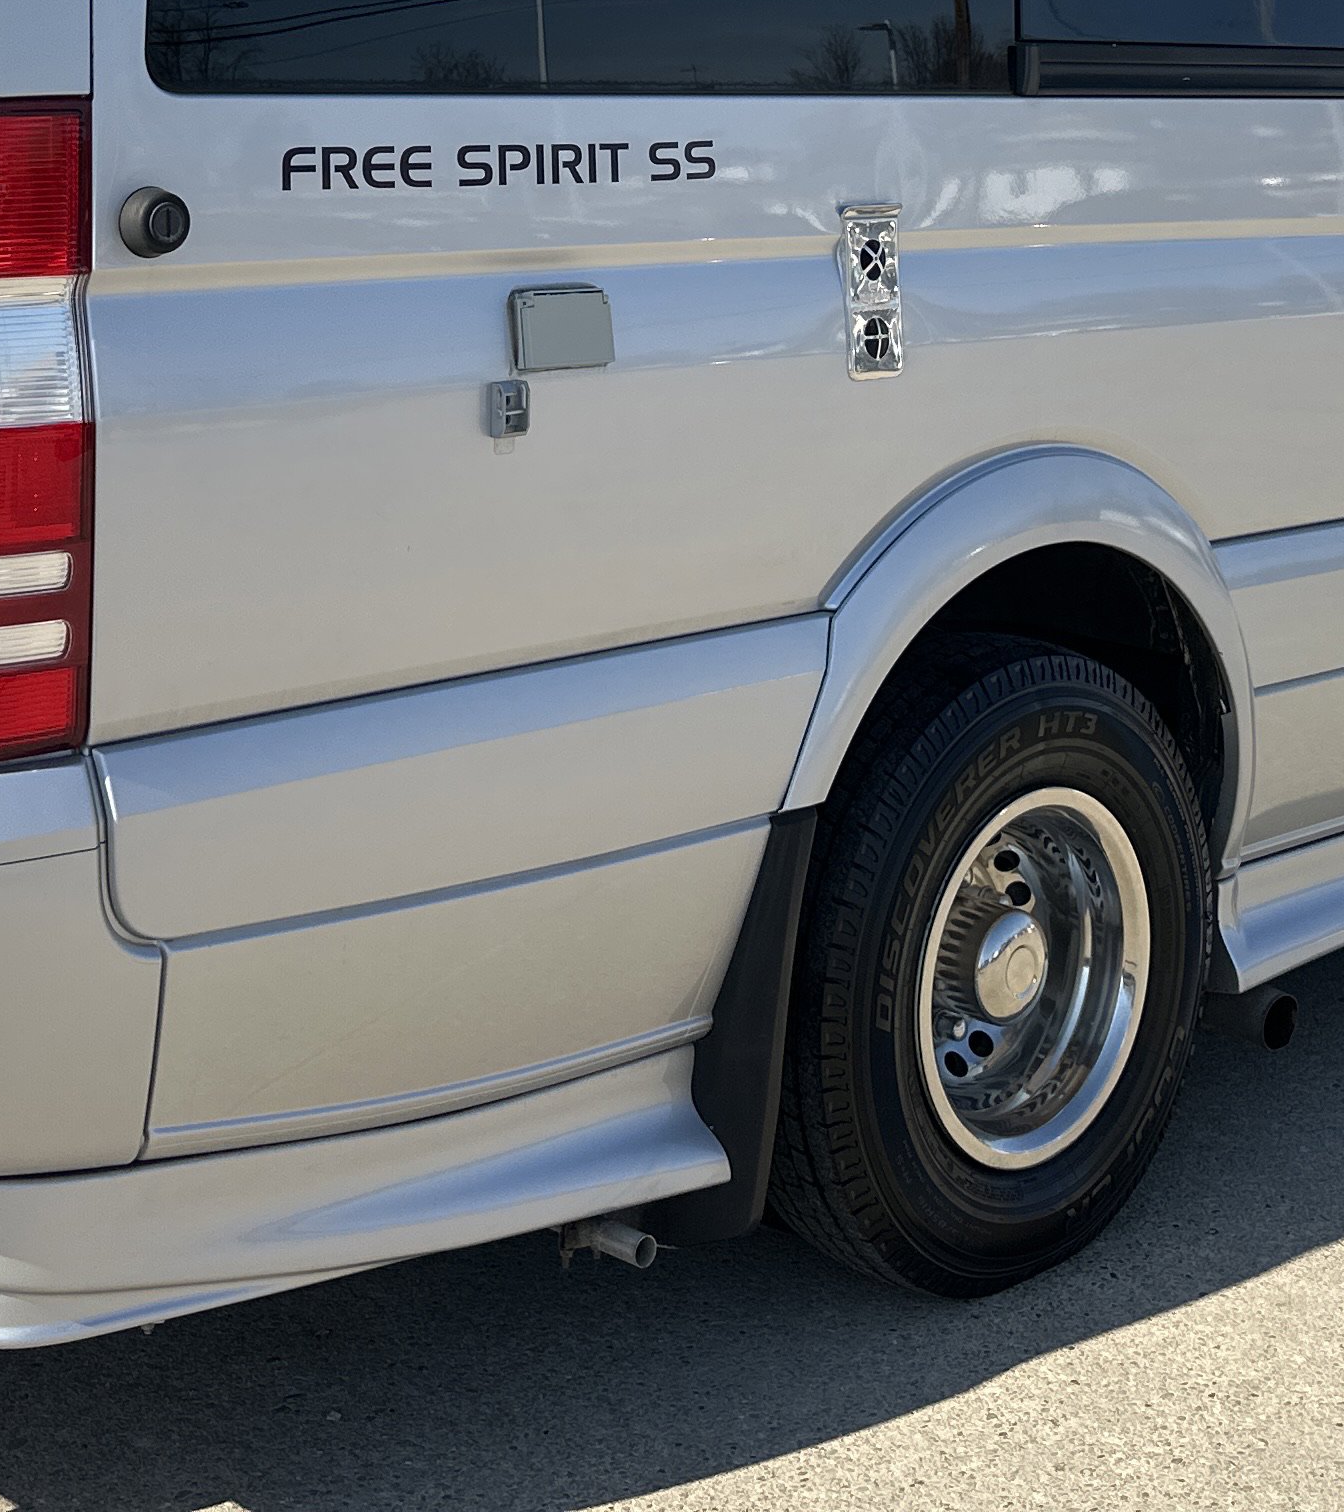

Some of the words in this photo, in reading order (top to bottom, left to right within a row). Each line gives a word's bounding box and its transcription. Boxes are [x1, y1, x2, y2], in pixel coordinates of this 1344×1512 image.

[281, 144, 433, 191] FREE
[456, 141, 629, 187] SPIRIT
[648, 139, 716, 182] SS
[875, 727, 1022, 1033] DISCOVERER
[1037, 711, 1099, 739] HT3
